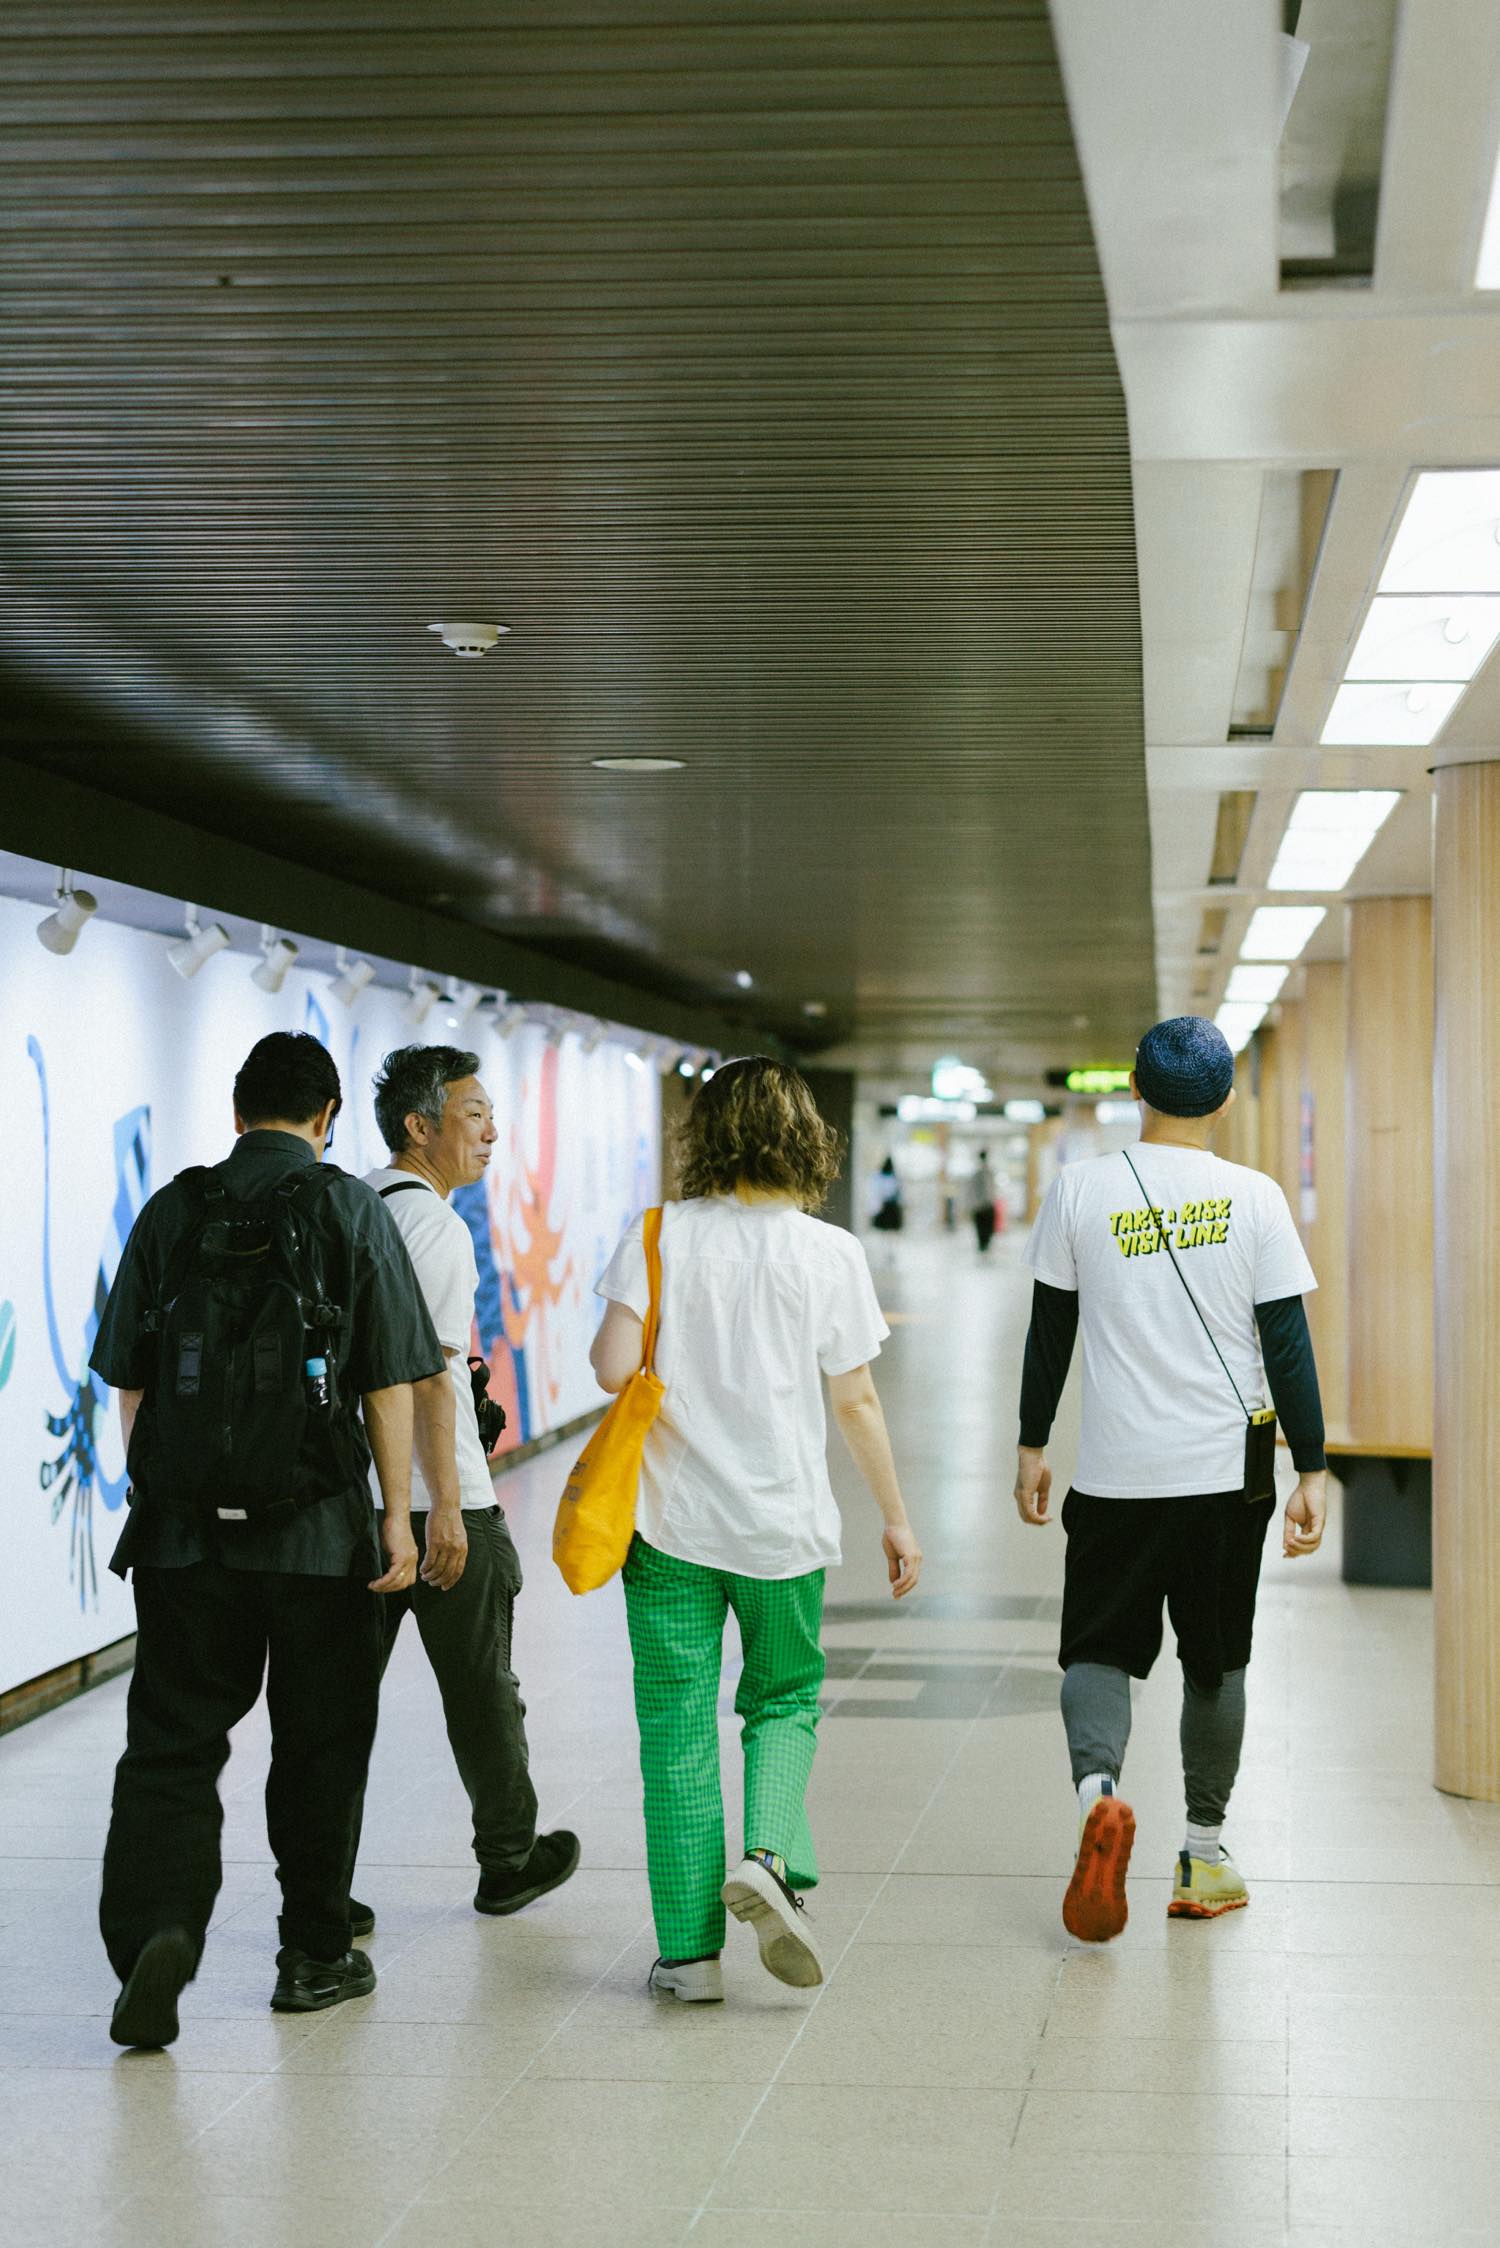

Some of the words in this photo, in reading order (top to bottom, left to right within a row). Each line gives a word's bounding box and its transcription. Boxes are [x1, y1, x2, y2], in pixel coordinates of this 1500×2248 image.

[1110, 1207, 1163, 1236] TAKE
[1167, 1209, 1177, 1223] A
[1180, 1198, 1232, 1224] RISK
[1117, 1228, 1173, 1257] VISIT
[1176, 1221, 1228, 1249] LINZ
